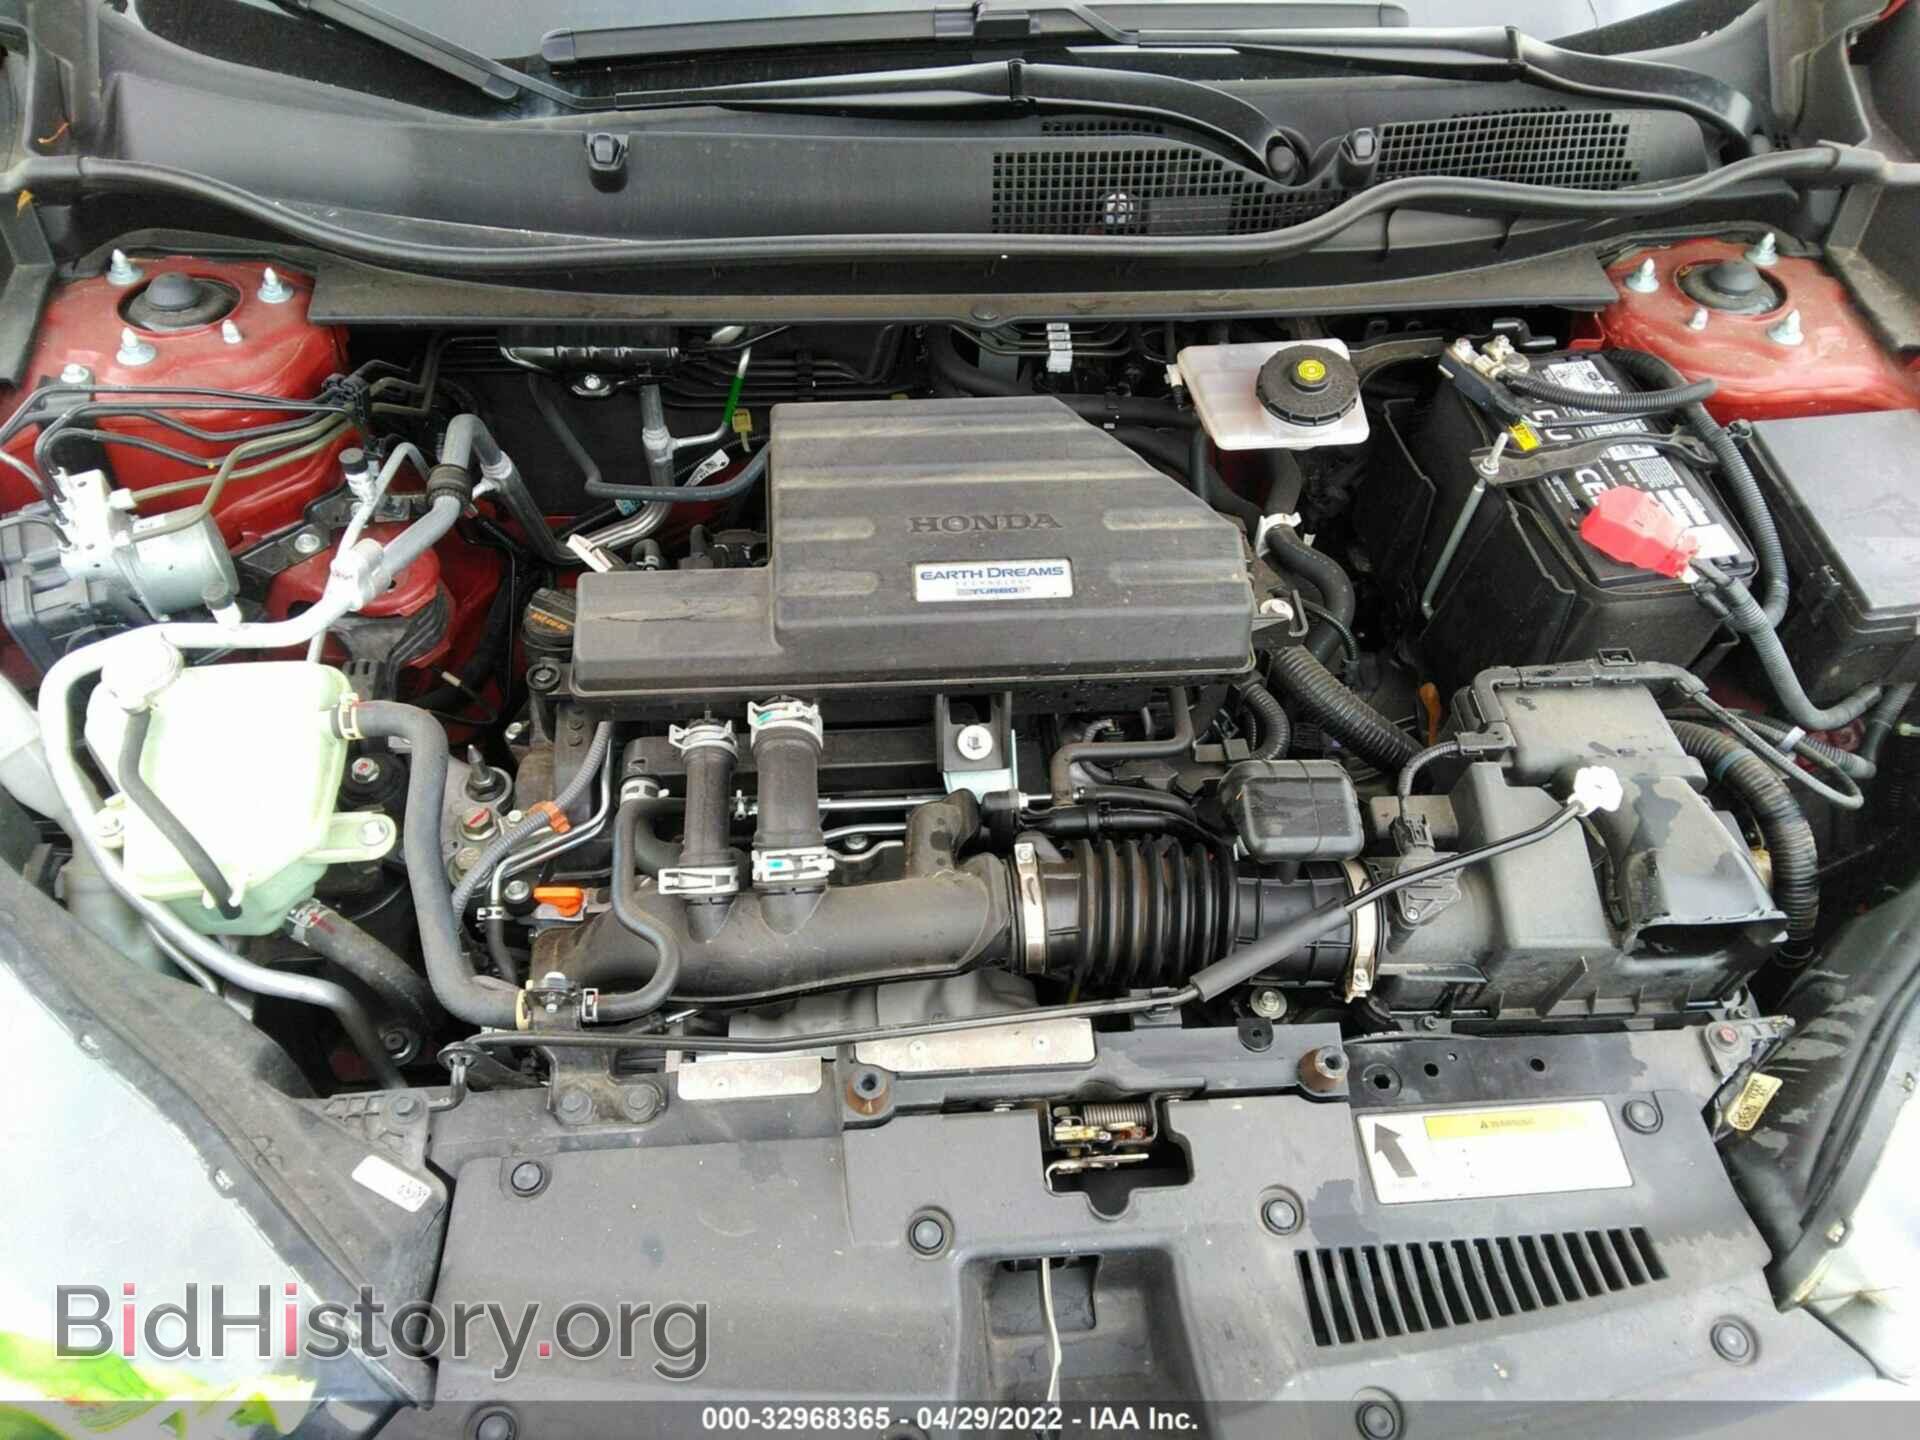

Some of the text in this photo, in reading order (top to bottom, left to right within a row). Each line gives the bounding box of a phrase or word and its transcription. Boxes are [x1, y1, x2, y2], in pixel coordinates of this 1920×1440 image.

[908, 513, 1064, 533] HONDA
[920, 569, 984, 581] EARTH
[973, 586, 1019, 596] TURBO
